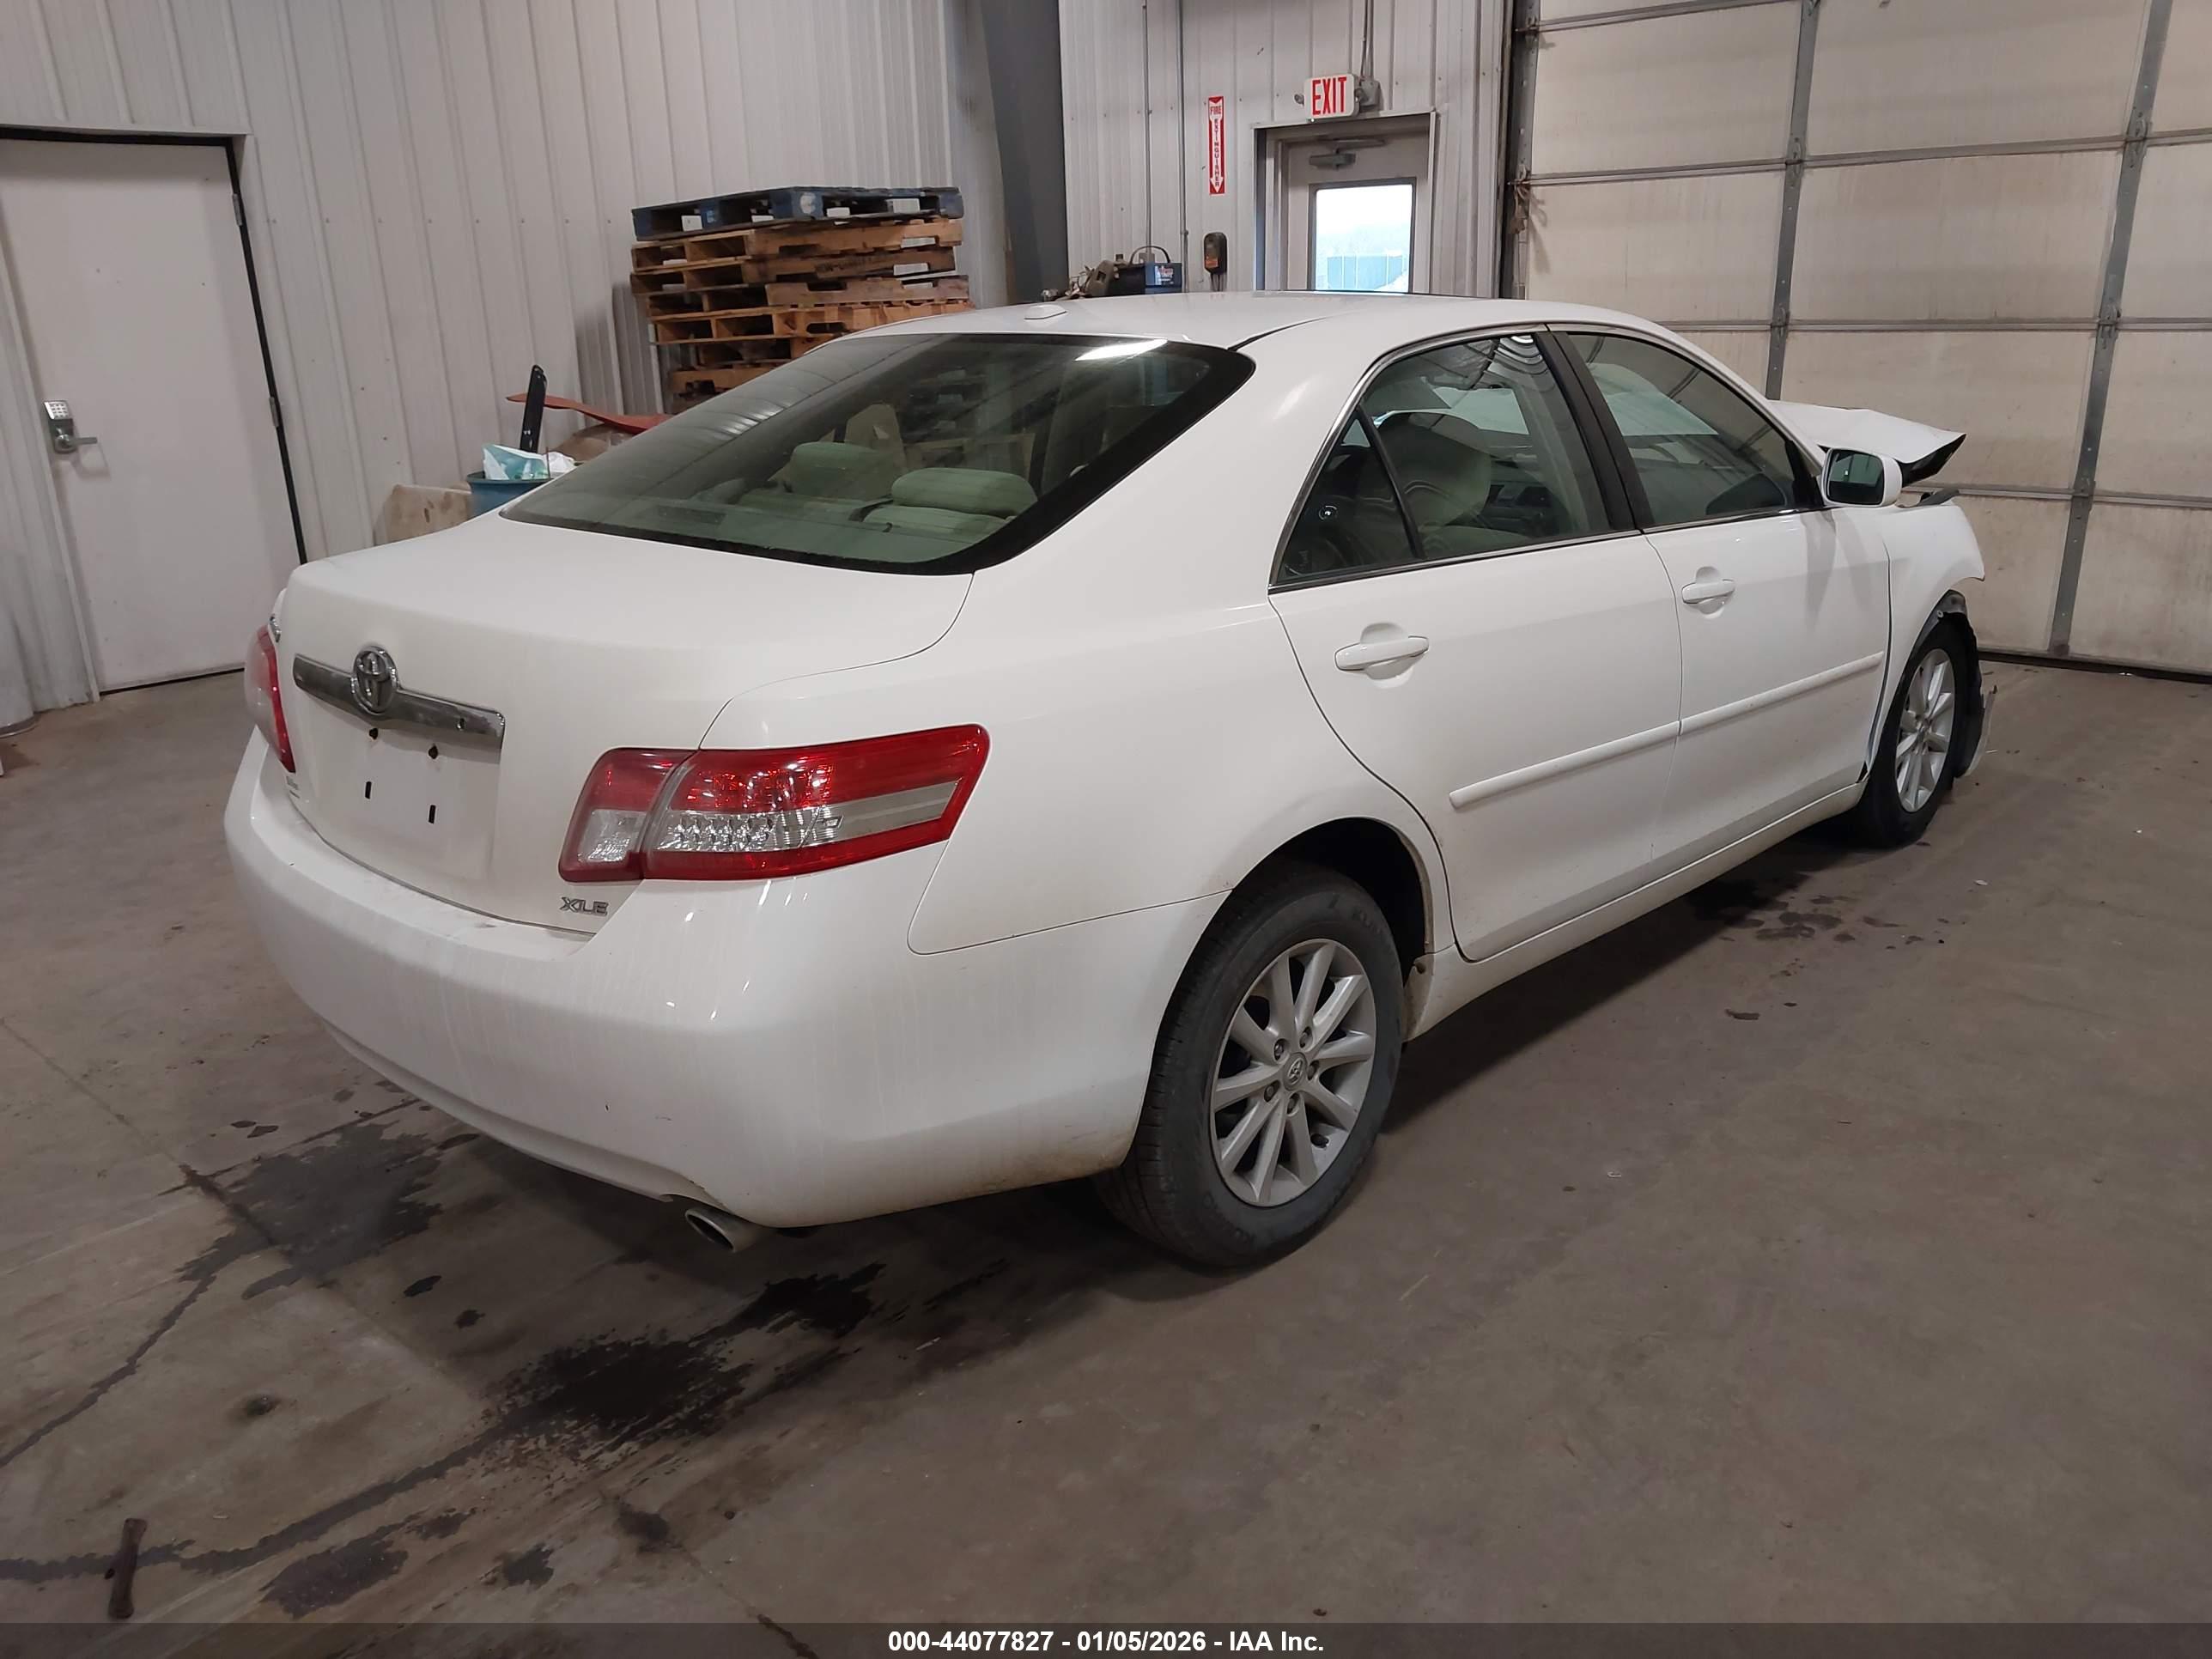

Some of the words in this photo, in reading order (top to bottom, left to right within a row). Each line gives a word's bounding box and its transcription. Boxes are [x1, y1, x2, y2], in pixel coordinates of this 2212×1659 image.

[1312, 76, 1347, 116] EXIT
[1209, 106, 1222, 115] FIRE
[559, 896, 610, 917] XLE
